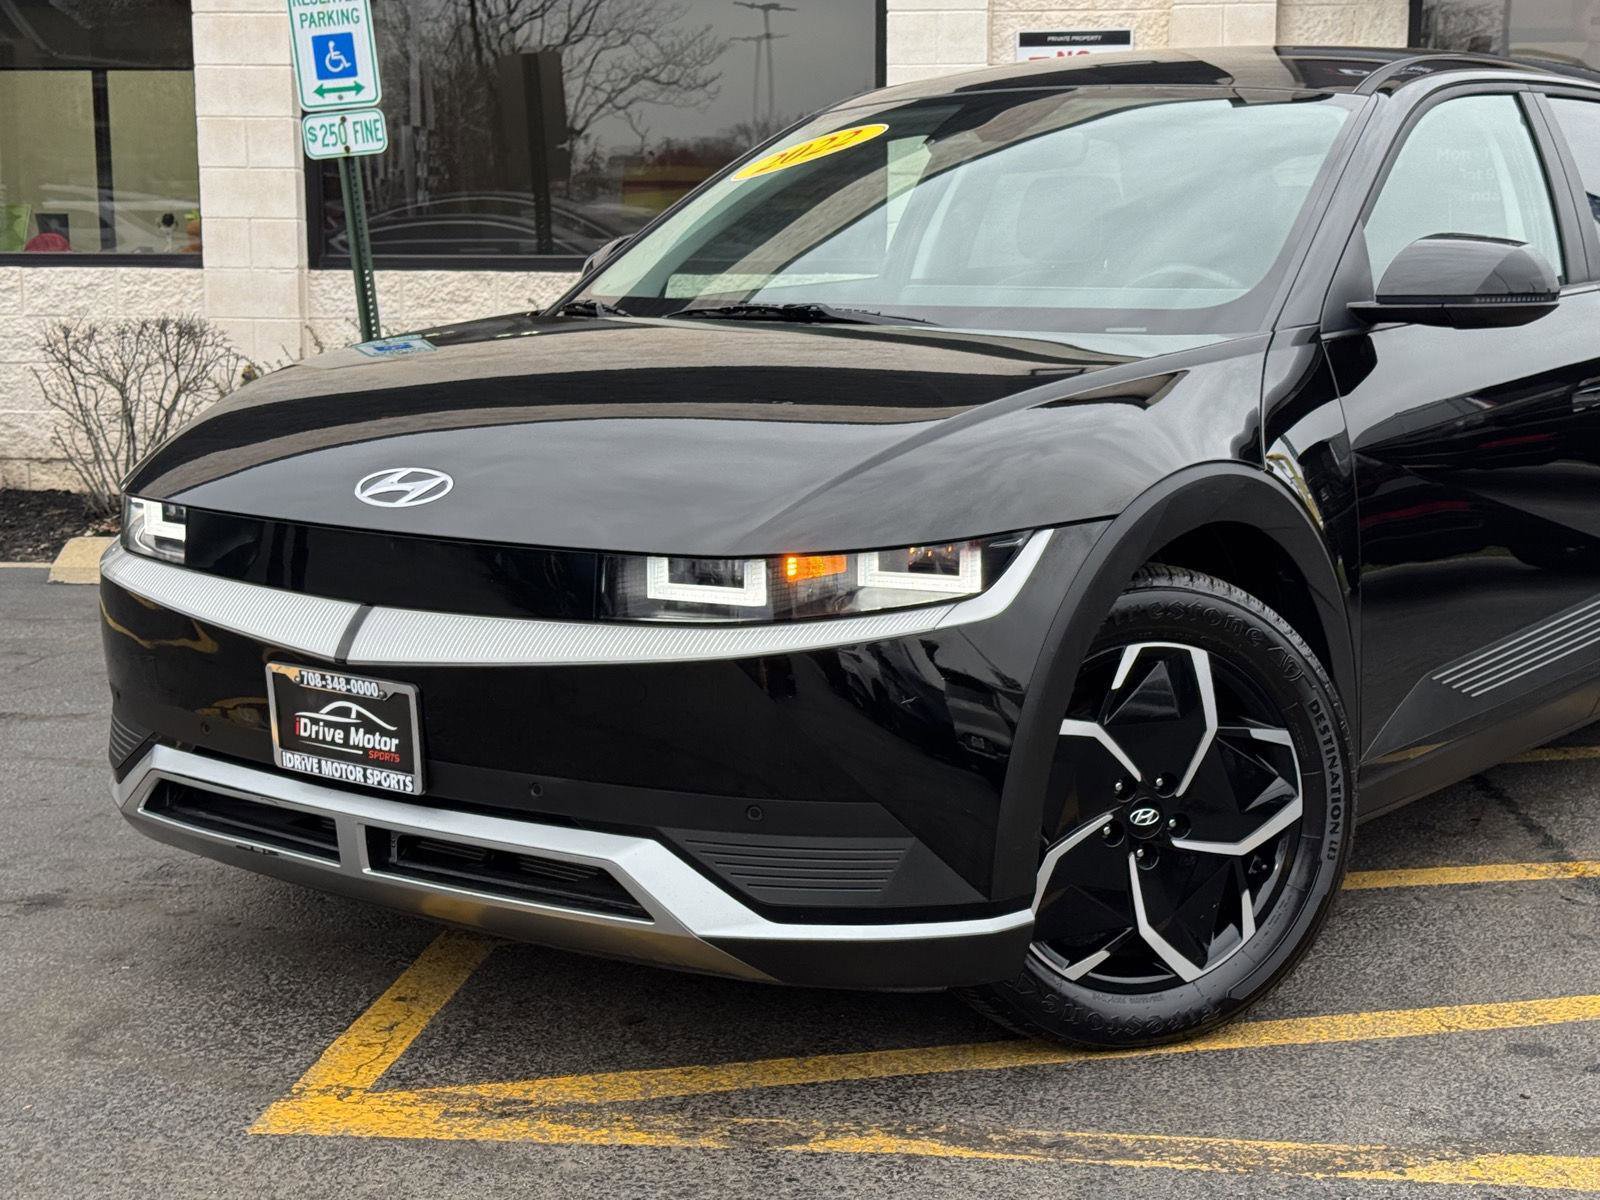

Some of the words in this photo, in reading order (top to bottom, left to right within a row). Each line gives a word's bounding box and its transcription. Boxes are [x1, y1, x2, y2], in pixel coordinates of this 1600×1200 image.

[299, 8, 360, 29] PARKING
[1071, 34, 1103, 42] PROPERTY
[307, 121, 348, 148] $250
[352, 118, 383, 145] FINE
[301, 671, 379, 697] 708-348-0000
[295, 716, 344, 744] iDrive
[349, 727, 399, 752] Motor
[368, 749, 401, 763] SPORTS
[1308, 698, 1343, 836] DESTINATION
[321, 760, 364, 784] MOTOR
[366, 769, 414, 793] SPORTS
